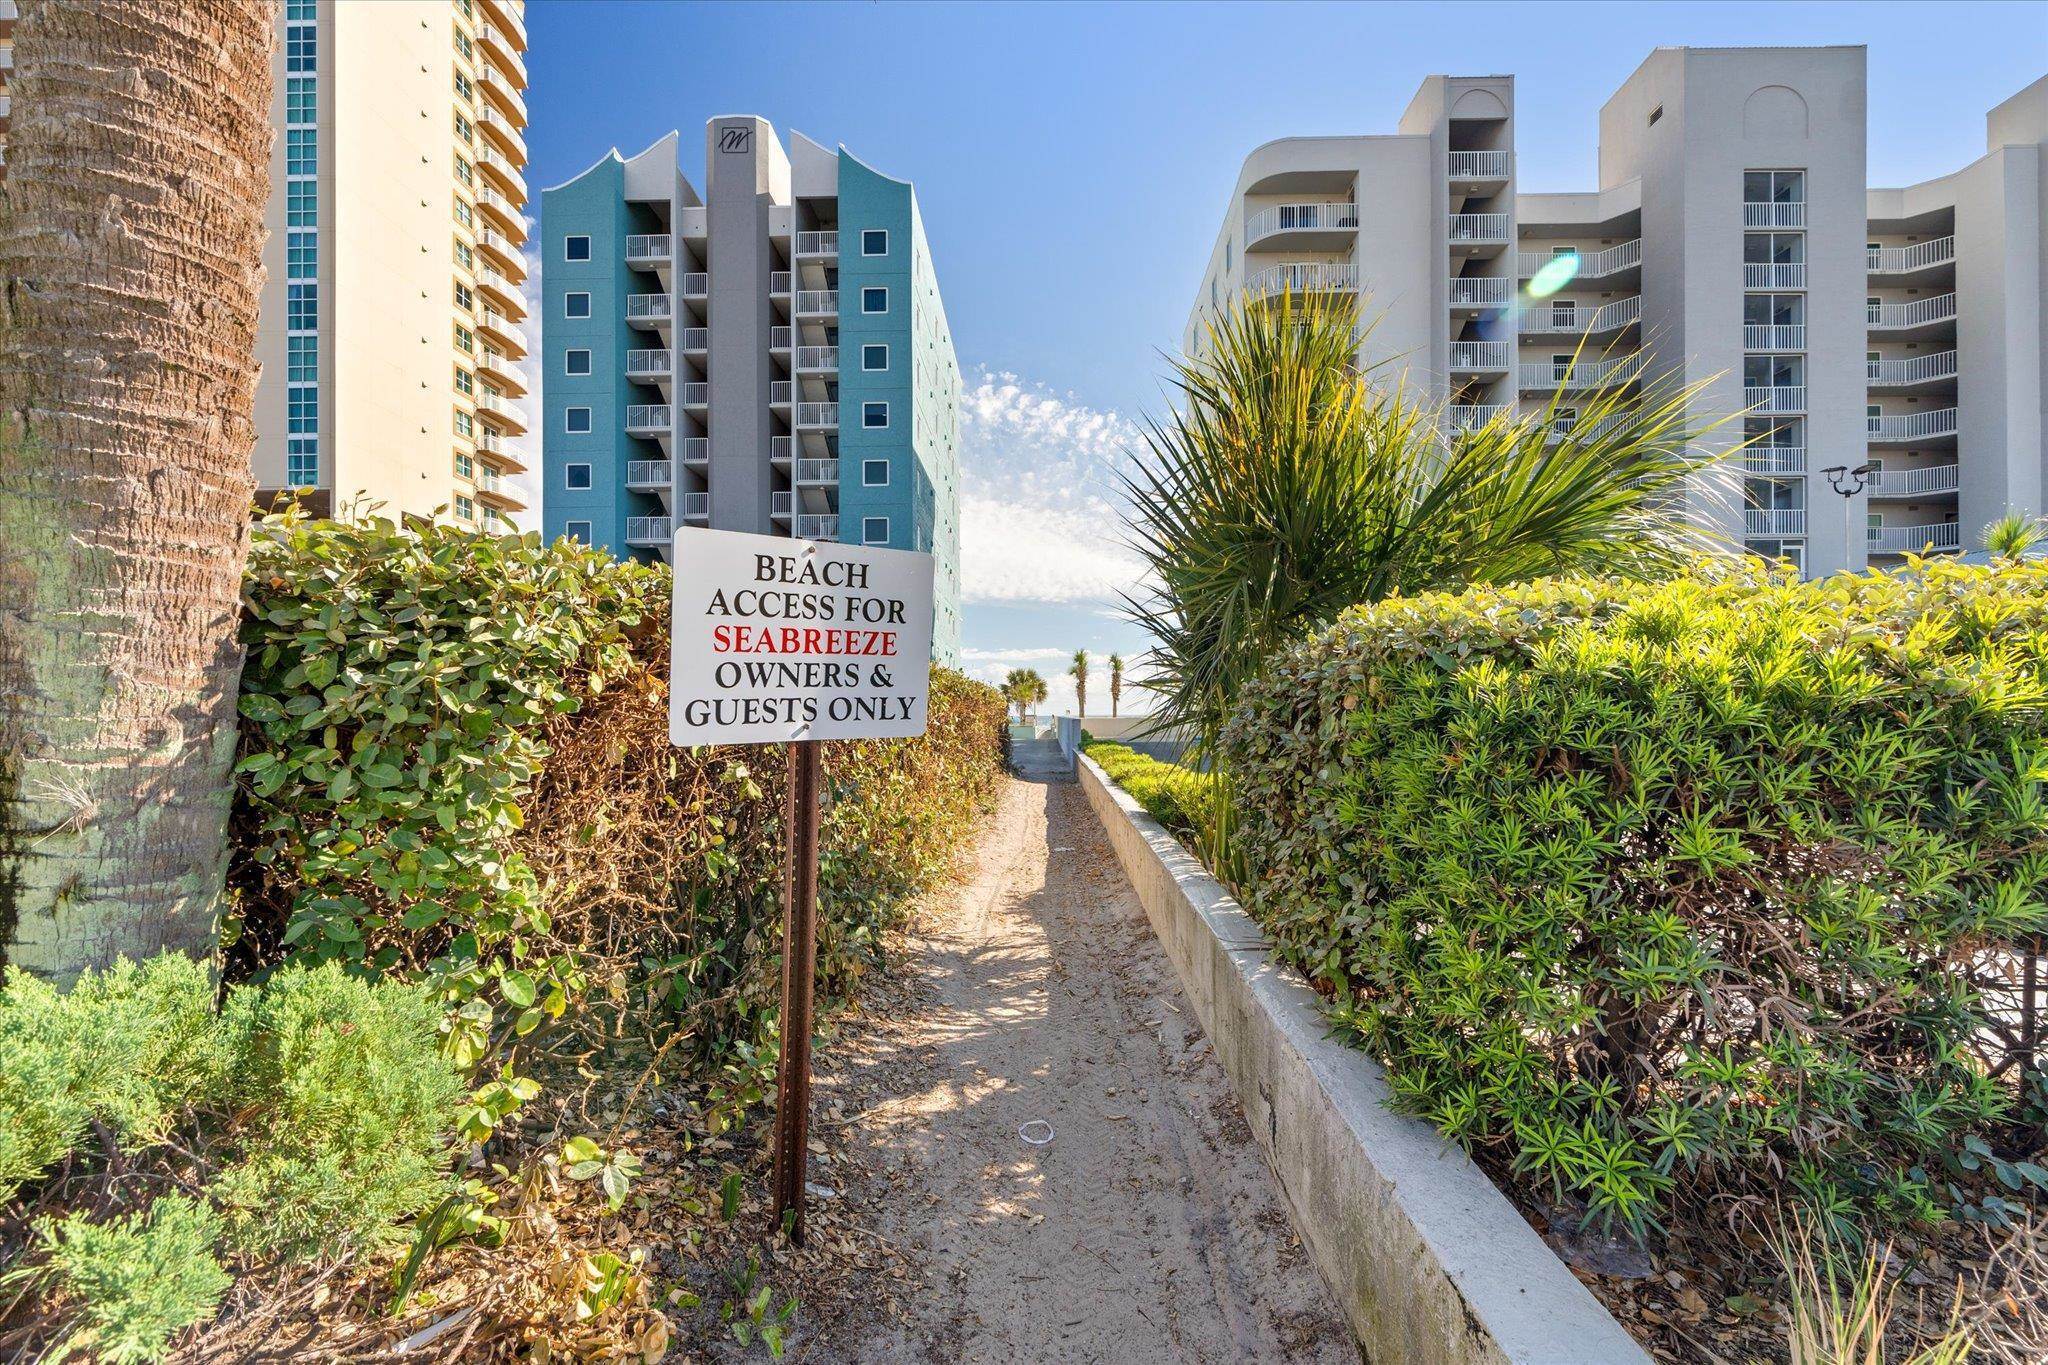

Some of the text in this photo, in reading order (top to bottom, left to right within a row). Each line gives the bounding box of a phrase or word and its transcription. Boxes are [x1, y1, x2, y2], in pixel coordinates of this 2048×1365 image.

[754, 554, 869, 589] BEACH
[705, 588, 906, 625] ACCESS FOR
[713, 625, 898, 656] SEABREEZE
[715, 661, 895, 689] OWNERS &
[684, 696, 917, 727] GUESTS ONLY
